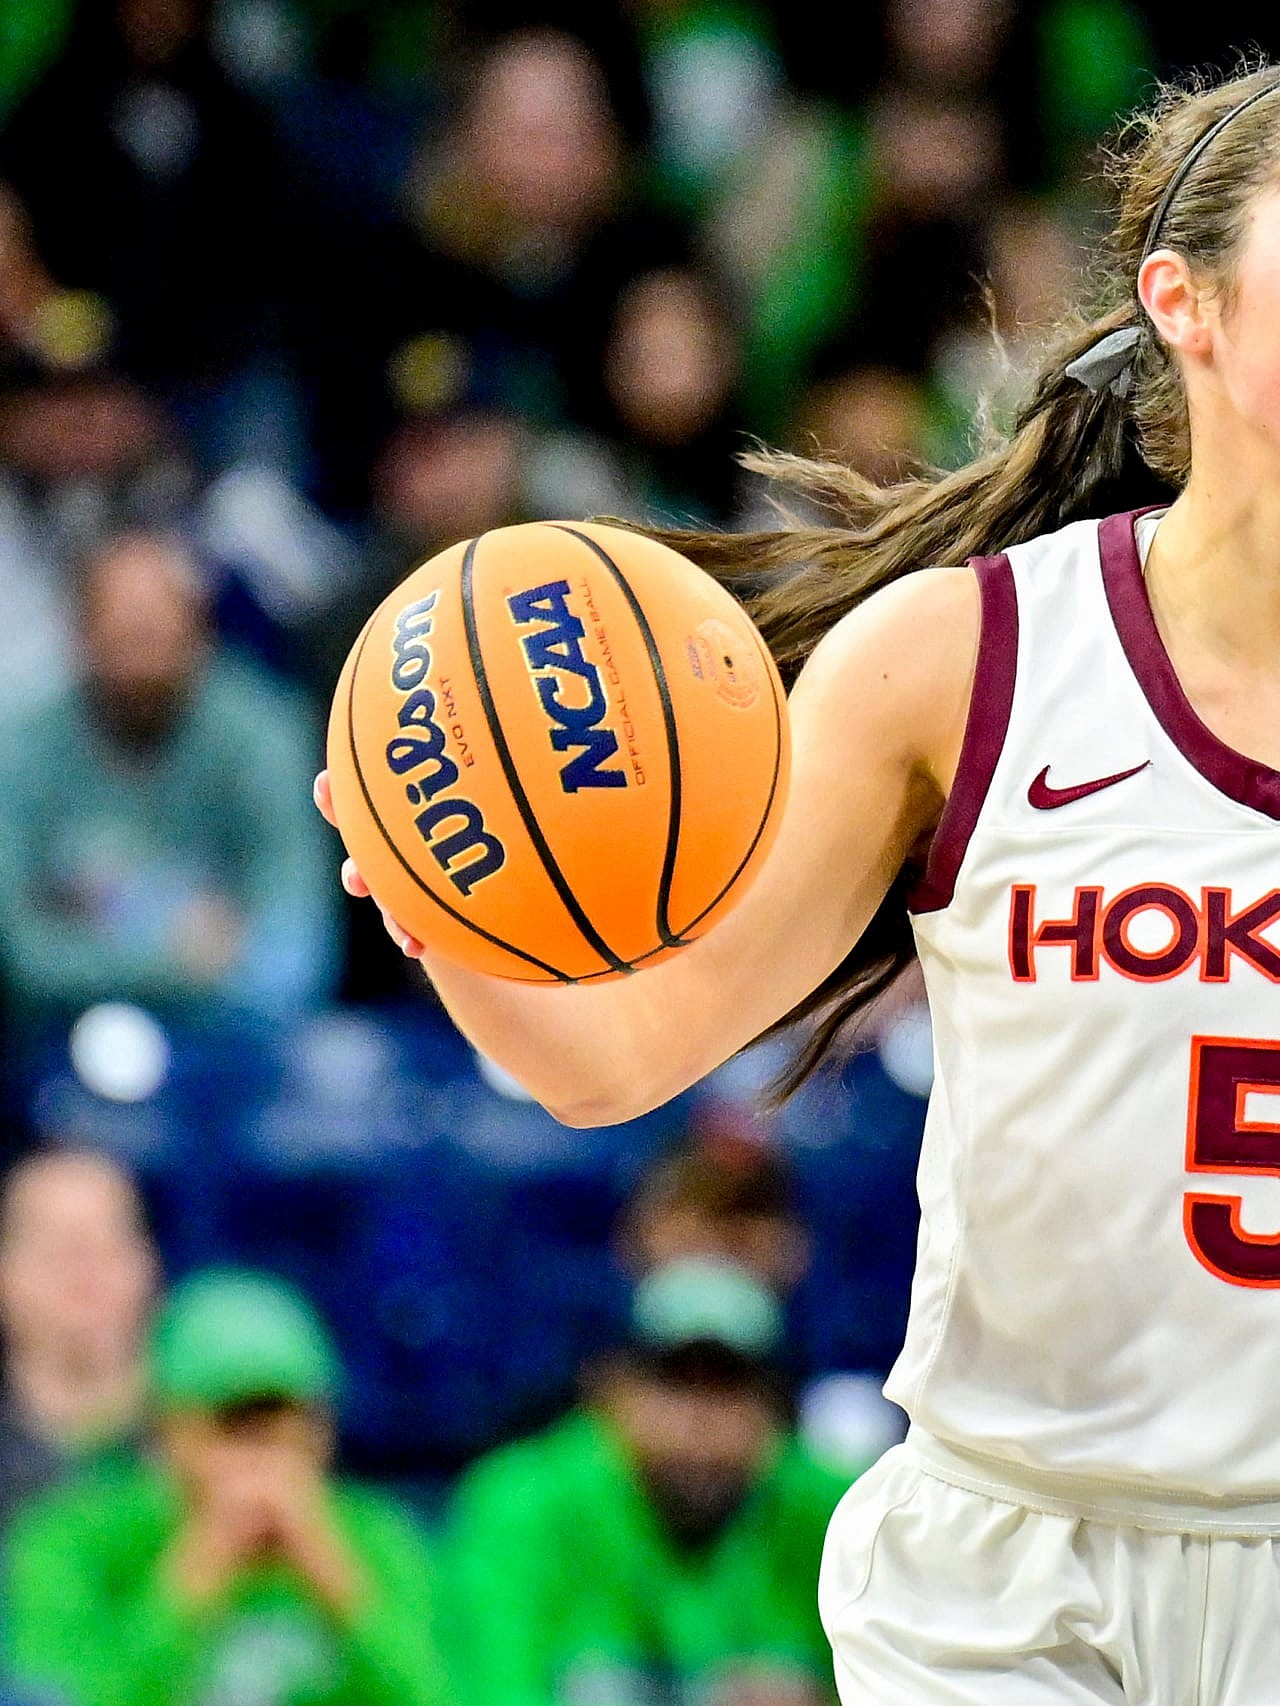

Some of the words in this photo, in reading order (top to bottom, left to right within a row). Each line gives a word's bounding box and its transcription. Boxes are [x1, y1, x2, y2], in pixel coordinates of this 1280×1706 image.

[581, 577, 601, 623] BALL
[507, 579, 628, 793] NCAA
[597, 623, 621, 687] GAME
[439, 677, 458, 719] NXT
[386, 591, 506, 897] Wilson
[451, 723, 476, 768] EVO
[617, 690, 647, 787] OFFICIAL
